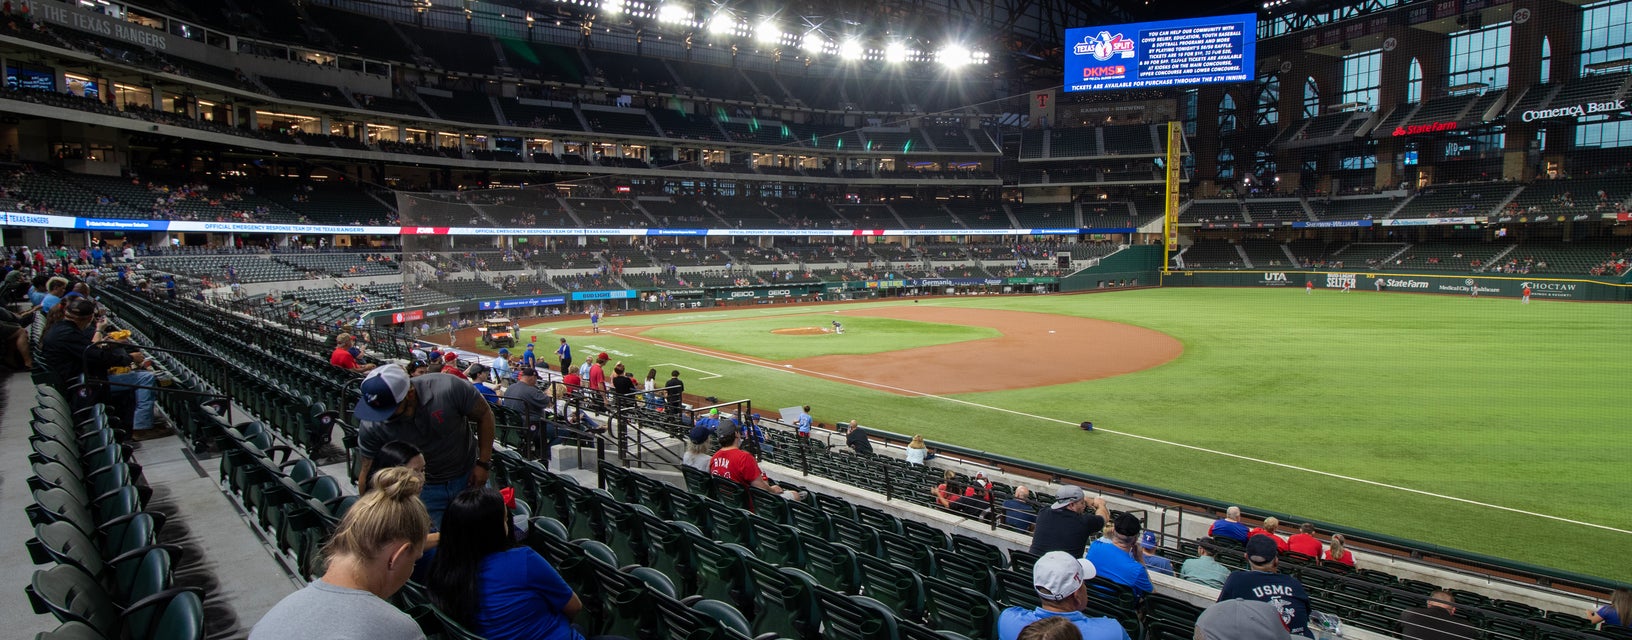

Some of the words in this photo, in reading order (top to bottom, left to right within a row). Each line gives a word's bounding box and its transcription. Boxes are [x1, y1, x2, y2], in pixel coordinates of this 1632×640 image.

[1514, 10, 1528, 20] 26
[42, 4, 68, 24] THE
[71, 12, 110, 36] TEXAS
[114, 23, 166, 50] RANGERS
[1385, 40, 1396, 48] 34
[1084, 66, 1115, 77] DKMS
[1037, 94, 1048, 108] T
[1586, 100, 1625, 113] Bank
[1524, 282, 1576, 290] CHOCTAW
[714, 457, 729, 469] RYAN
[1252, 585, 1293, 598] USMC
